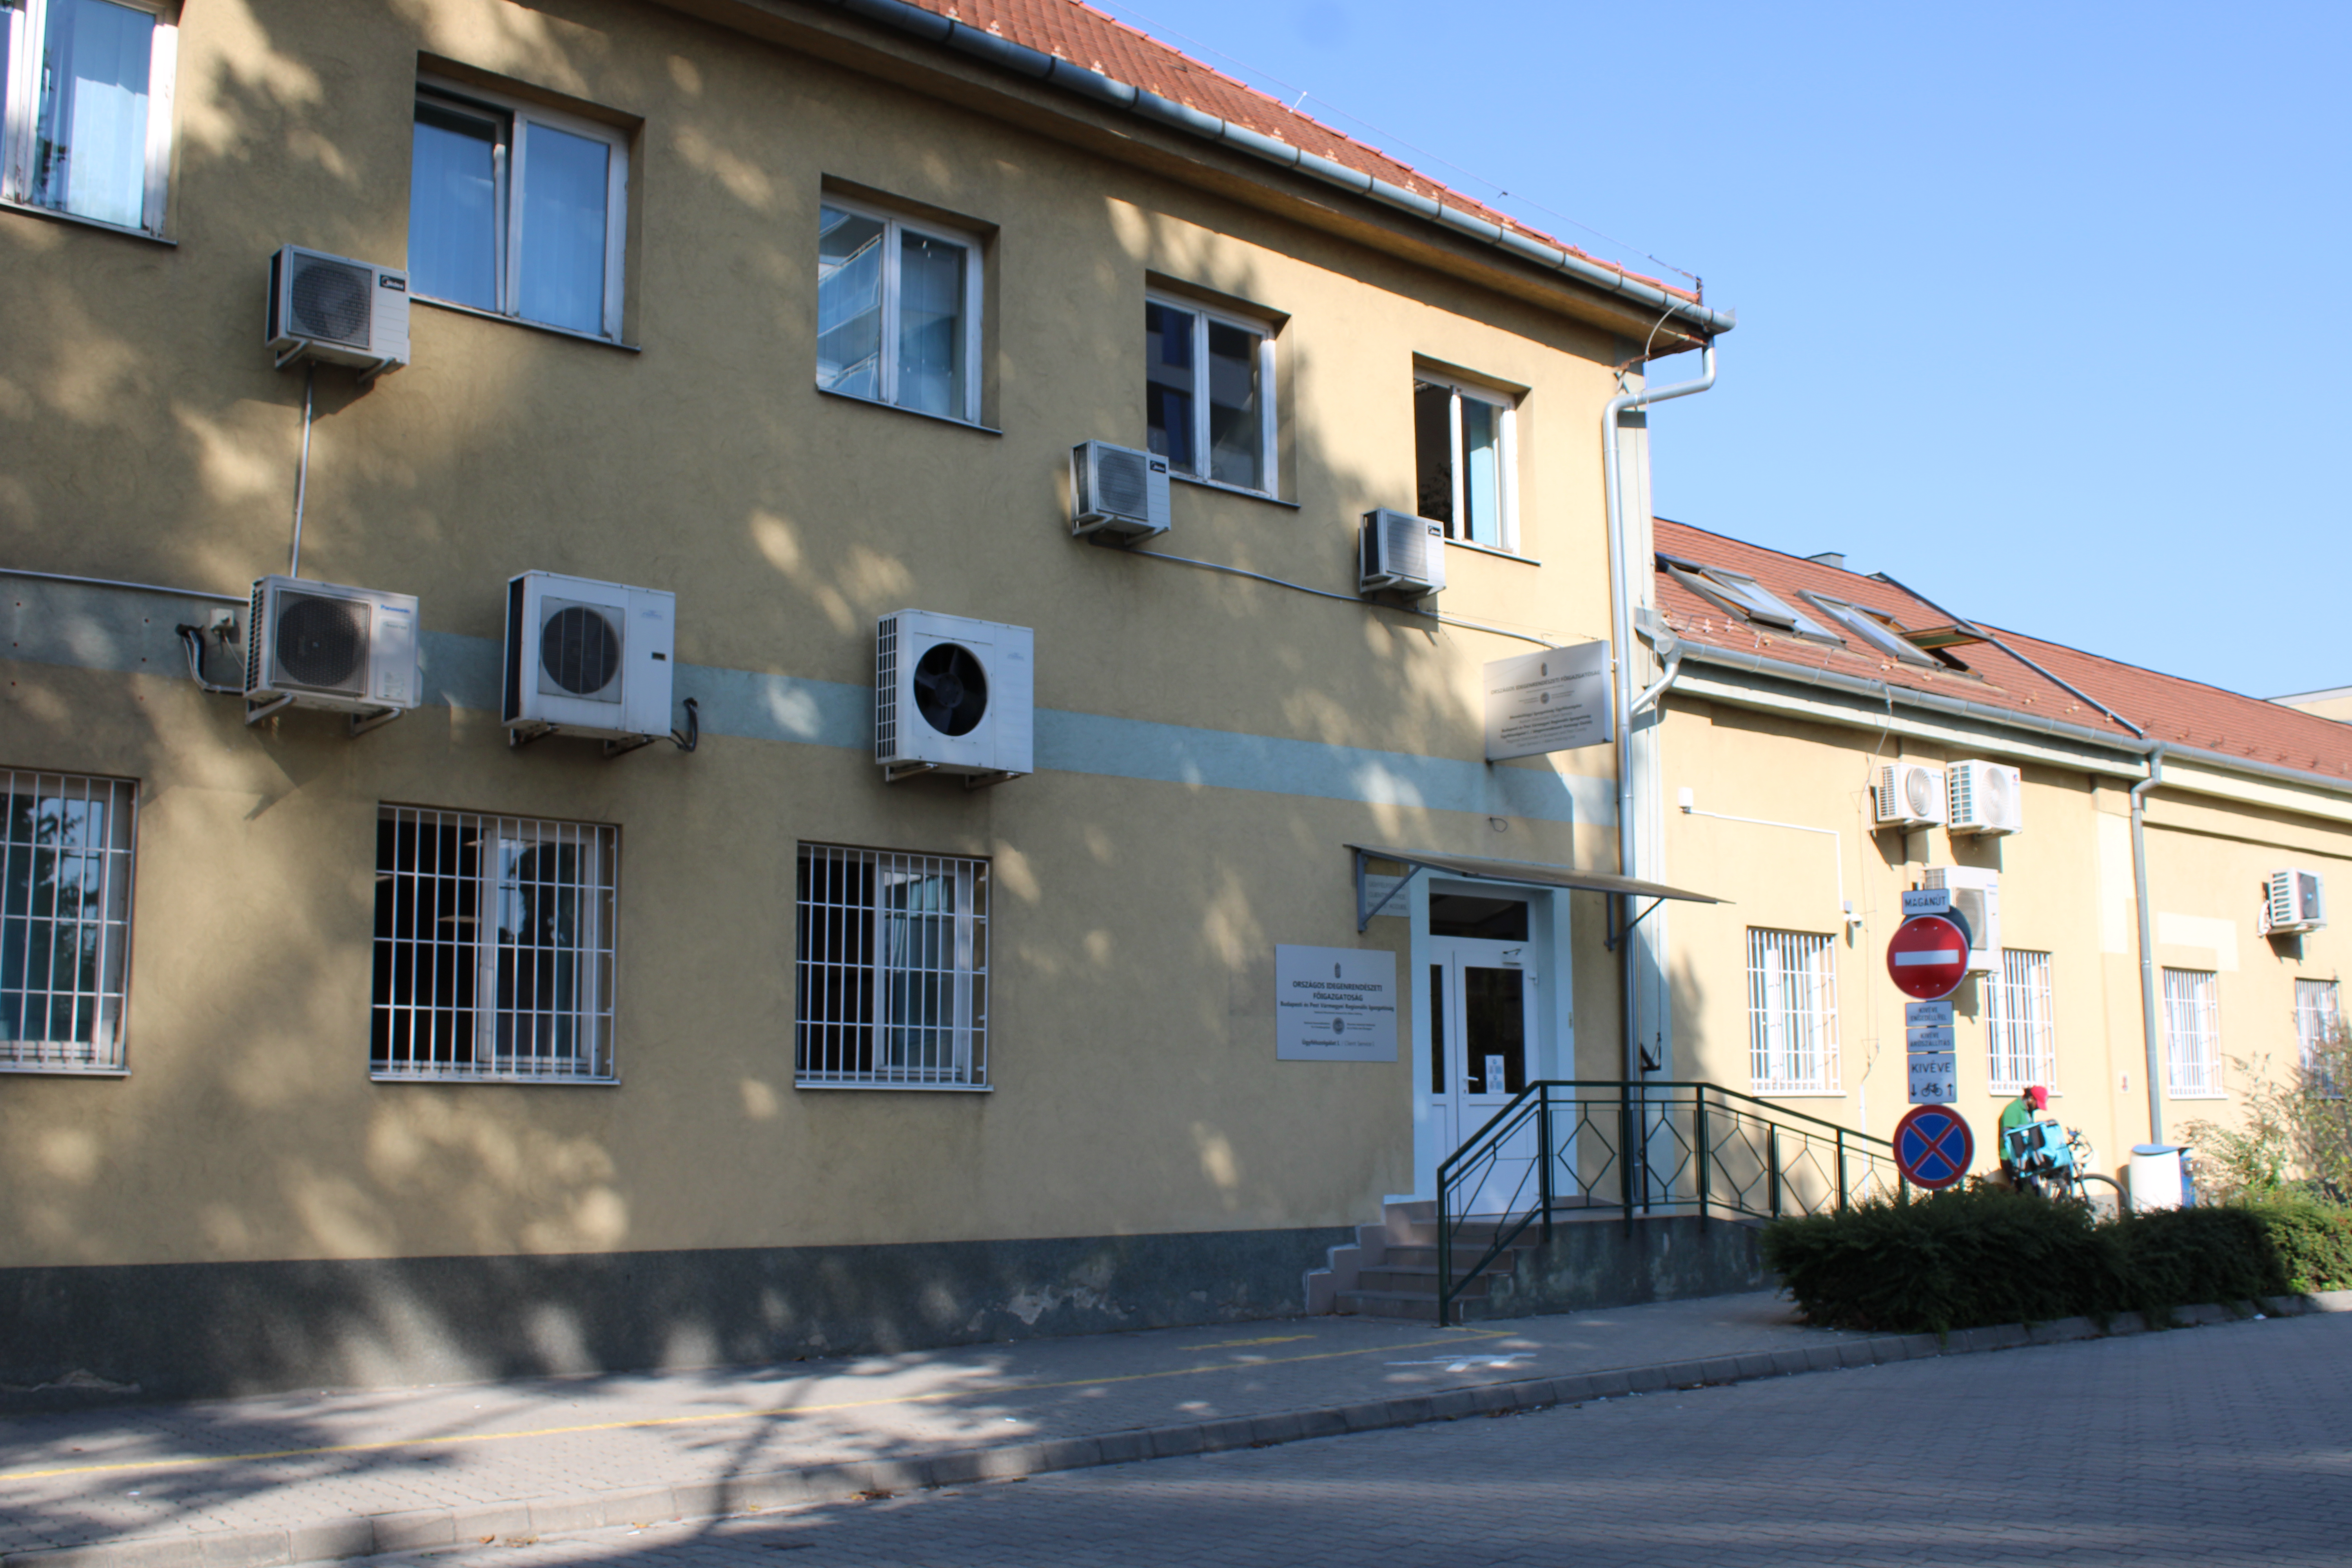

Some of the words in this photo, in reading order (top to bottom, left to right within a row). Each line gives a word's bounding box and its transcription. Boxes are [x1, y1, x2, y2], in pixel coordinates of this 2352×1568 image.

[380, 604, 410, 613] Panasonic
[1293, 980, 1325, 989] ORSZÁGOS
[1911, 1060, 1952, 1073] KIVÉVE
